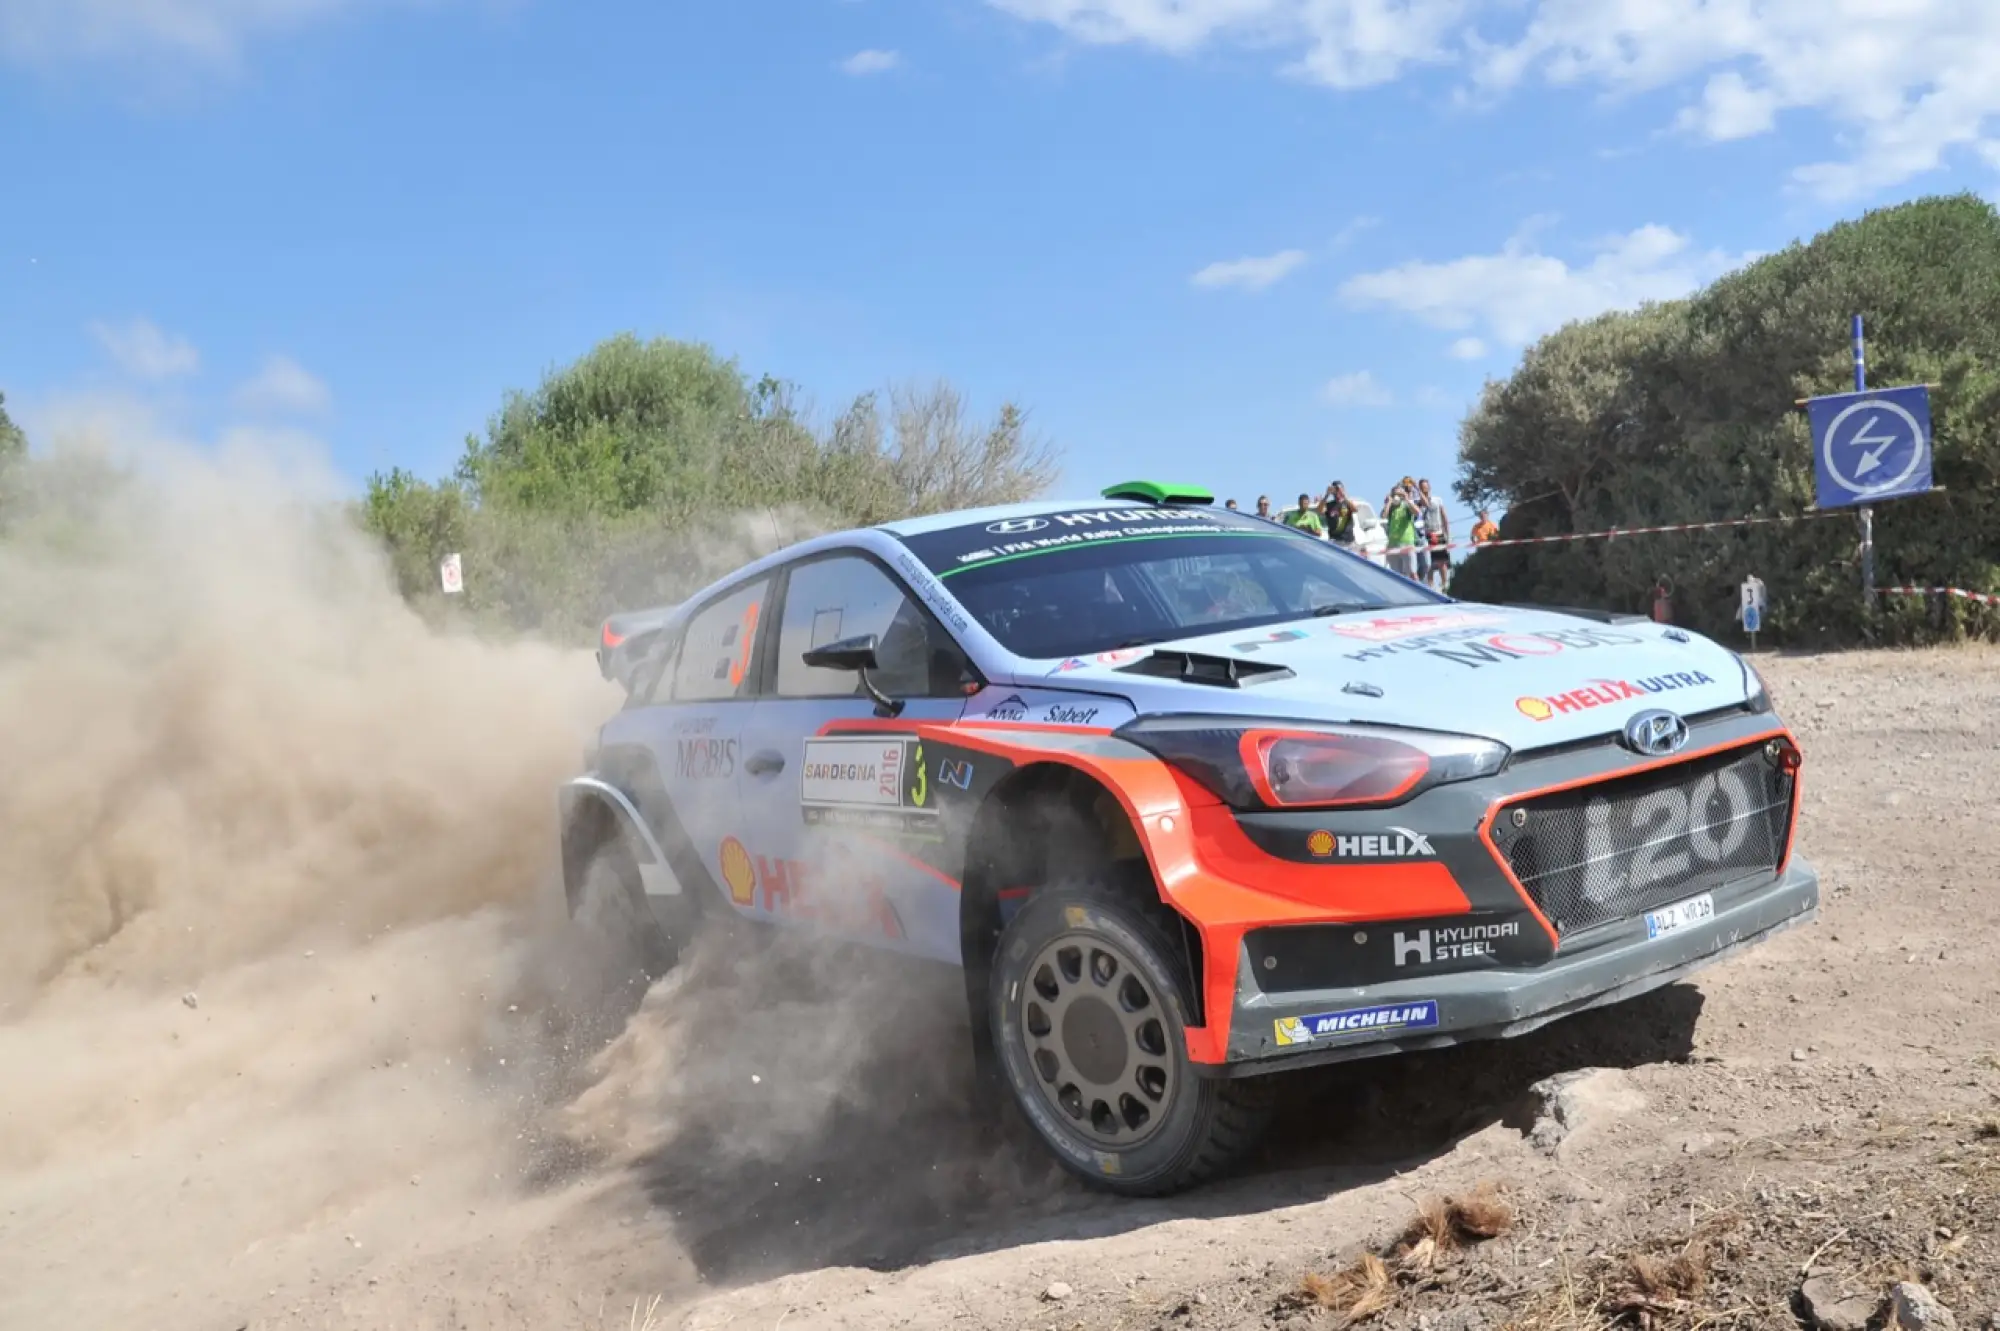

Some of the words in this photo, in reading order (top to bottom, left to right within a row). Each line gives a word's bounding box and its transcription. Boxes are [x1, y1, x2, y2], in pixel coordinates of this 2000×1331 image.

[1426, 626, 1644, 669] MOBIS
[1546, 679, 1646, 714] HELIX
[1636, 669, 1715, 693] ULTRA
[675, 738, 737, 780] MOBIS
[805, 763, 876, 782] SARDEGNA
[879, 748, 899, 797] 2016
[911, 744, 928, 807] 3
[1337, 829, 1436, 857] HELIX
[1435, 921, 1519, 943] HYUNDAI
[1436, 941, 1496, 960] STEEL
[1316, 1005, 1429, 1034] MICHELIN
